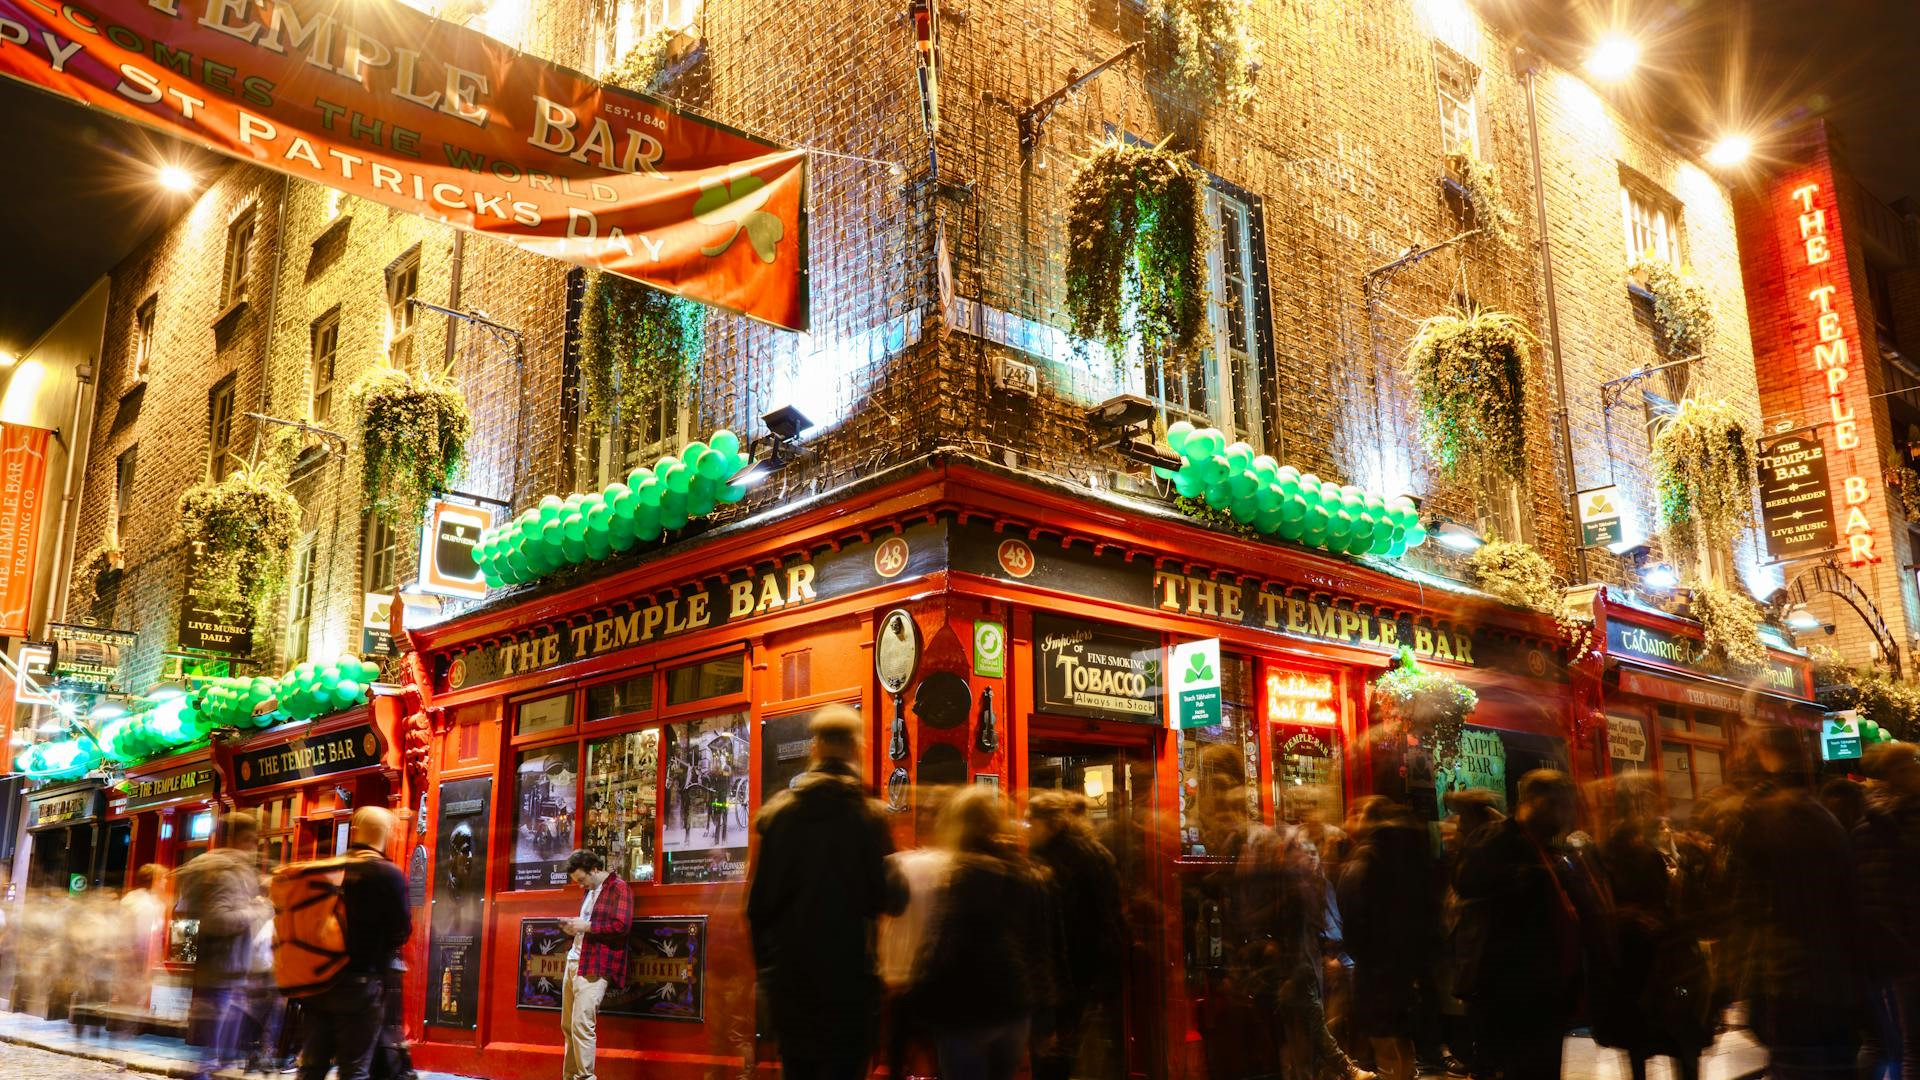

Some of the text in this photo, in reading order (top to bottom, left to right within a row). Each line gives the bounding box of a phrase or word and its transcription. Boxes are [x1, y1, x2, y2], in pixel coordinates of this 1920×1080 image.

[148, 0, 671, 181] EMPLE BAR
[115, 62, 205, 120] ST
[237, 109, 542, 228] PATRICK'S
[566, 205, 666, 263] DAY
[315, 96, 422, 158] THE
[442, 142, 620, 204] WORLD
[1793, 183, 1877, 564] THE TEMPLE BAR
[1760, 447, 1823, 470] TEMPLE
[1778, 441, 1800, 453] THE
[6, 462, 23, 494] BAR
[1775, 464, 1811, 481] BAR
[1766, 489, 1826, 508] BEER GARDEN
[1772, 520, 1828, 537] LIVE MUSIC
[1785, 532, 1816, 544] DAILY
[14, 512, 32, 577] TRADING
[880, 543, 903, 571] 48
[1004, 543, 1027, 569] 48
[188, 621, 246, 635] LIVE MUSIC
[500, 563, 817, 675] THE TEMPLE BAR
[1156, 571, 1475, 664] THE TEMPLE BAR
[200, 632, 233, 643] DAILY
[1041, 629, 1093, 655] Importers
[1073, 645, 1084, 654] OF
[1087, 652, 1145, 671] FINE SMOKING
[1055, 654, 1147, 699] TOBACCO
[1076, 693, 1153, 713] Always in Stock
[257, 738, 356, 777] THE TEMPLE BAR
[541, 958, 566, 974] POWE
